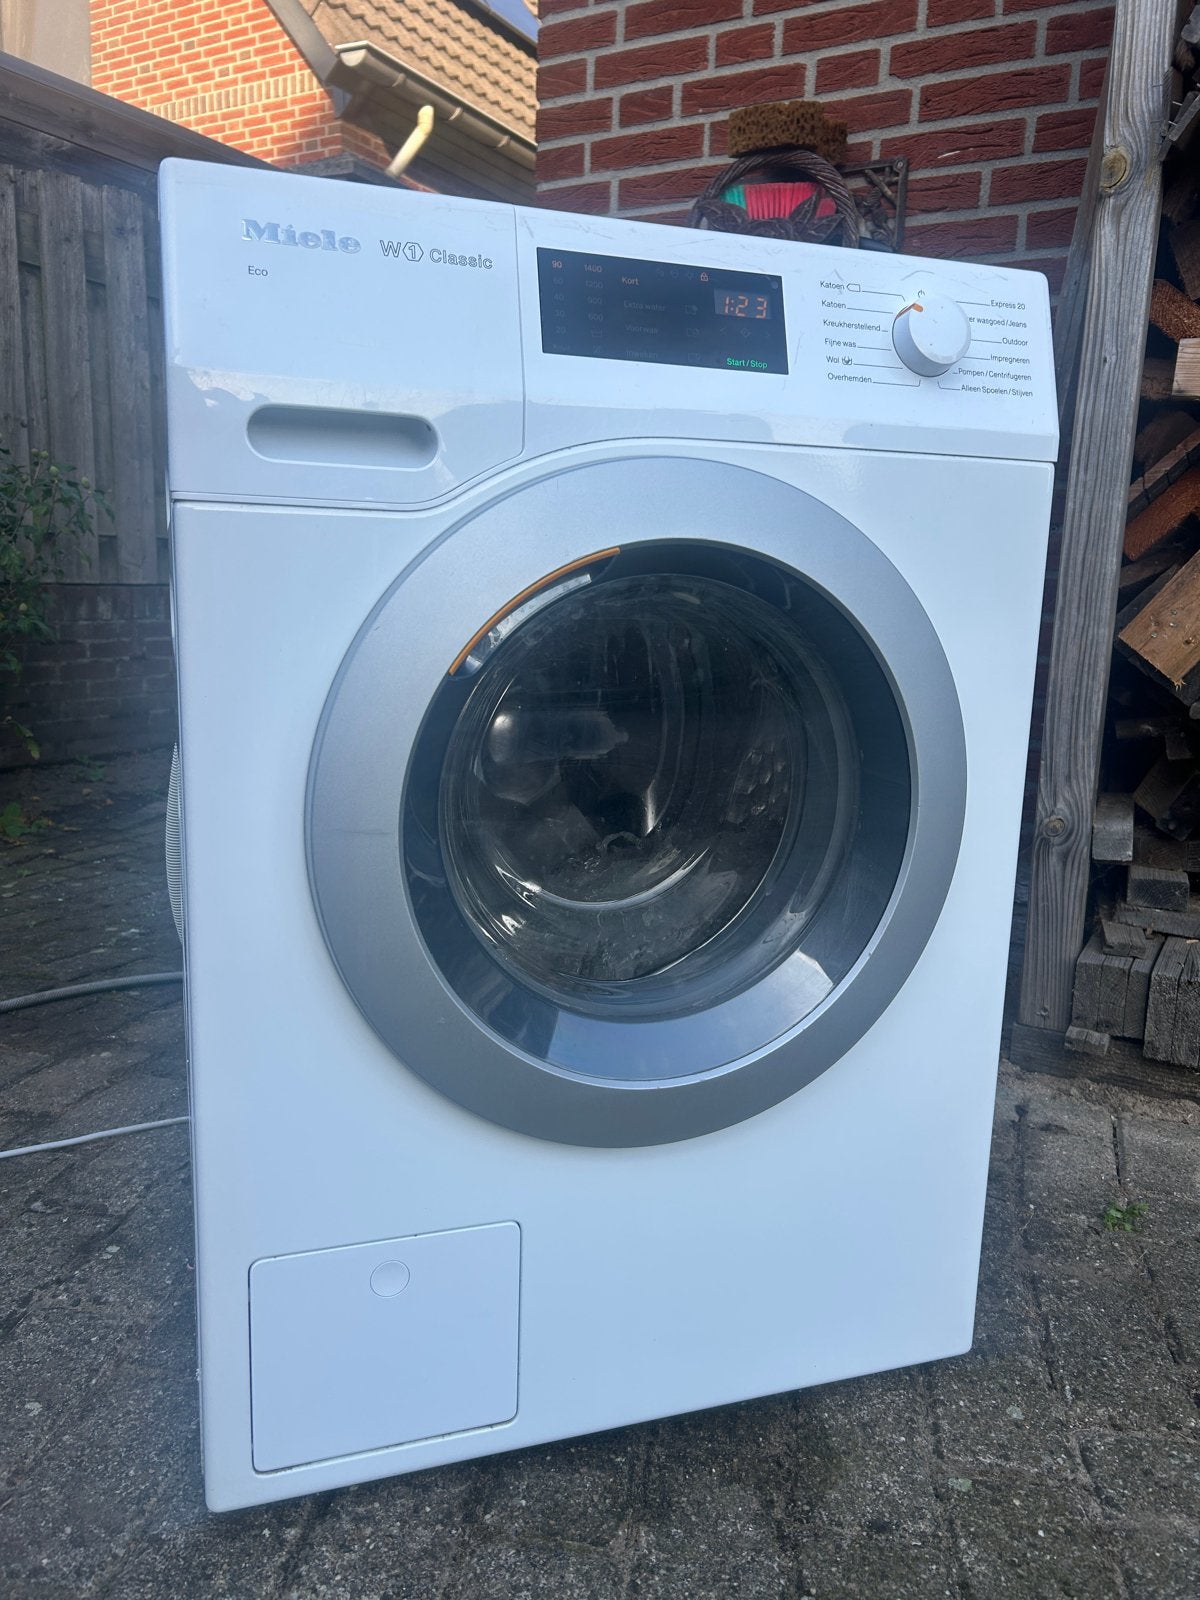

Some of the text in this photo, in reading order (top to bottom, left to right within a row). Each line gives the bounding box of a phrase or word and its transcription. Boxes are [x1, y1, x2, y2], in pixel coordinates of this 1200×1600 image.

[241, 218, 361, 254] Miele
[430, 248, 493, 269] Classic
[552, 260, 563, 269] 90
[248, 265, 268, 277] Eco
[622, 276, 639, 286] Kort
[820, 281, 845, 291] Katoen
[724, 295, 768, 319] 1:23
[821, 300, 847, 310] Katoen
[990, 299, 1026, 311] Express 20
[823, 319, 881, 332] Kreukherstellend
[824, 338, 857, 349] Fijne was
[1002, 337, 1029, 347] Outdoor
[826, 356, 839, 364] Wol
[990, 354, 1031, 366] Impregneren
[827, 372, 873, 384] Overhemden
[961, 384, 982, 393] Alleen
